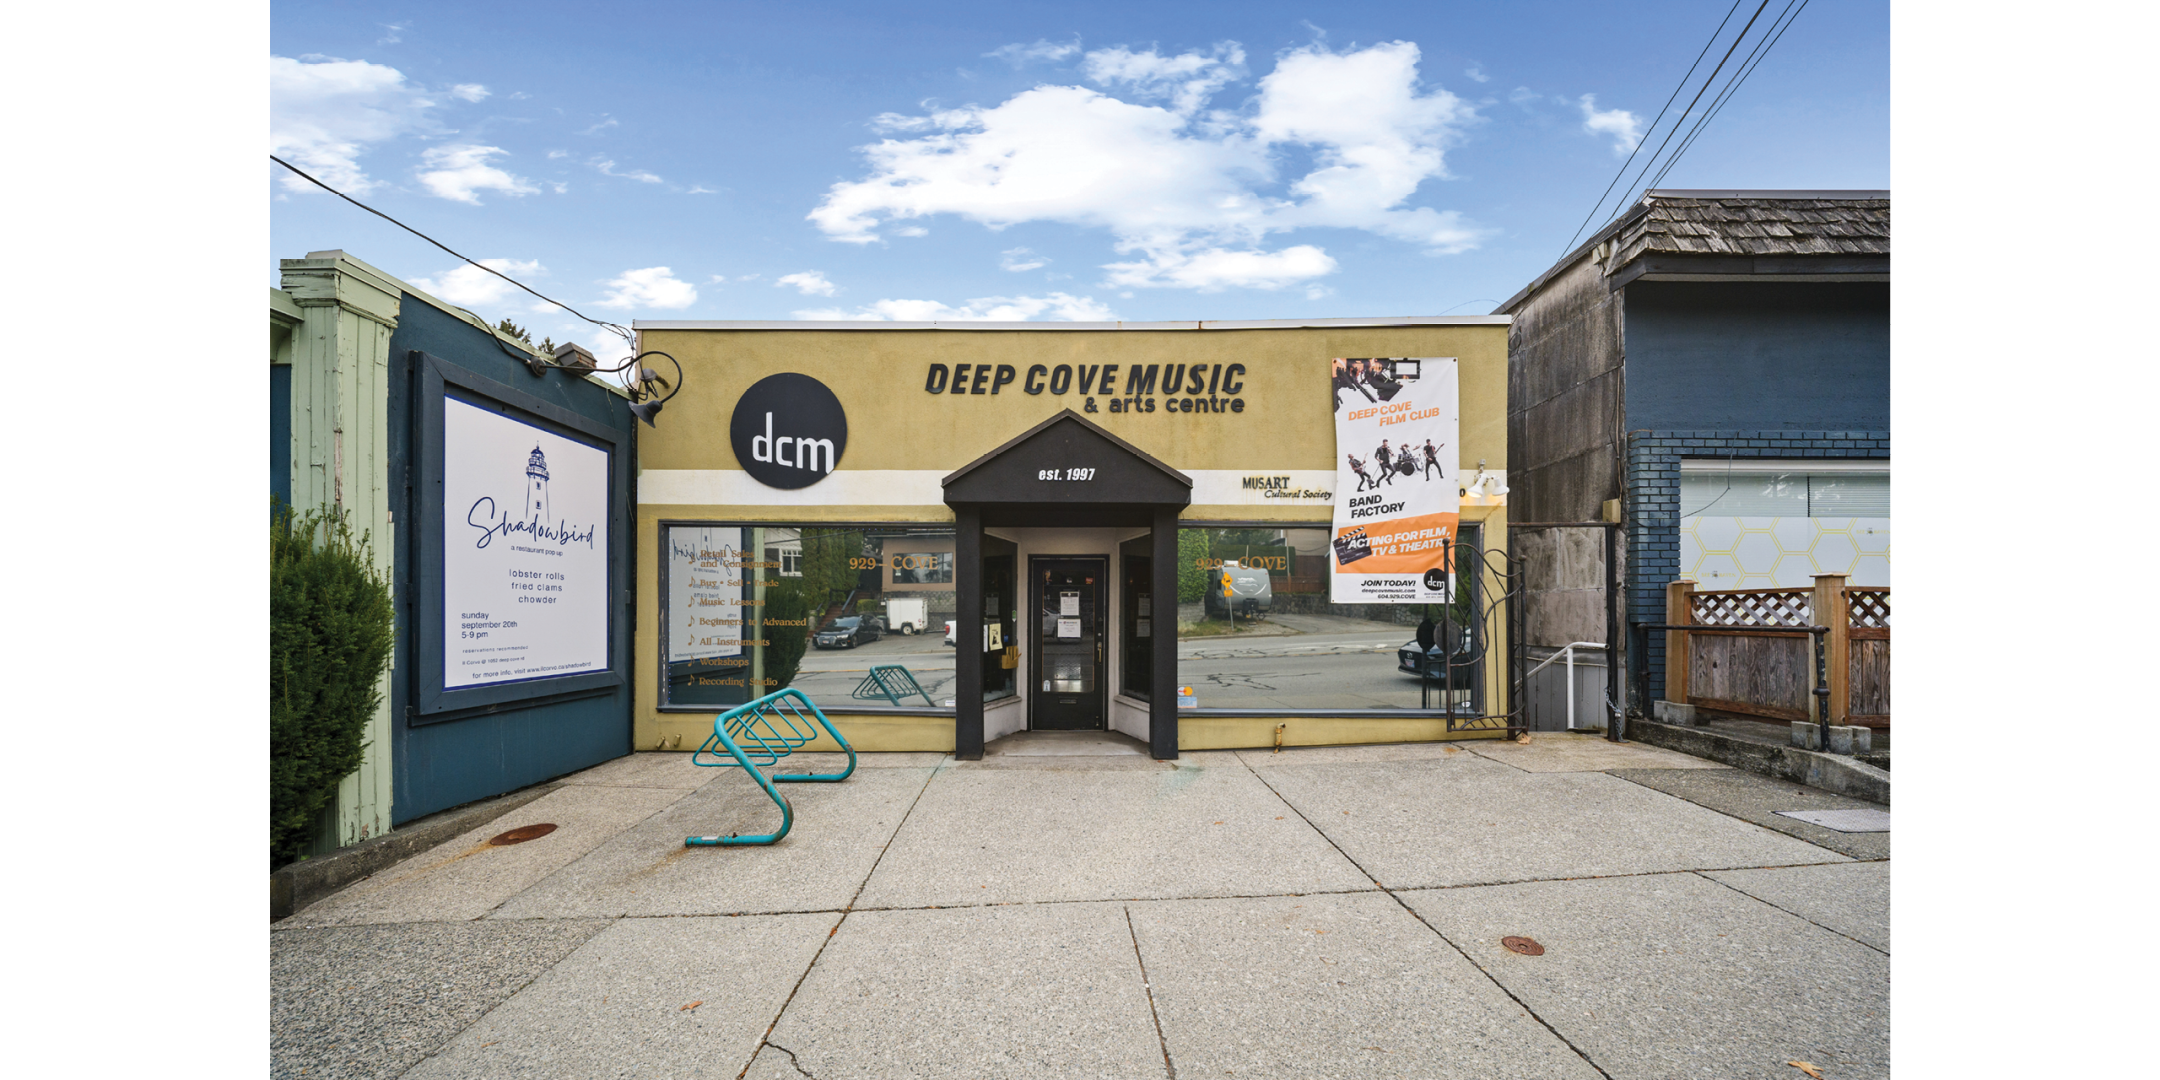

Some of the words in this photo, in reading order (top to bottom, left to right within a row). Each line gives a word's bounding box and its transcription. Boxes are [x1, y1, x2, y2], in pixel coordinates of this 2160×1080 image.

[925, 363, 1016, 395] DEEP
[1024, 363, 1119, 395] COVE
[1125, 363, 1246, 395] MUSIC
[1084, 397, 1098, 413] &
[1109, 395, 1156, 413] arts
[1165, 394, 1245, 413] centre
[1348, 407, 1378, 421] DEEP
[1379, 401, 1412, 415] COVE
[1379, 414, 1406, 427] FILM
[1409, 407, 1440, 421] CLUB
[752, 411, 834, 474] dcm
[1038, 469, 1062, 481] est.
[1066, 468, 1095, 481] 1997
[1242, 476, 1290, 489] MUSART
[1264, 489, 1301, 498] Cultural
[1302, 489, 1332, 500] Society
[1349, 494, 1382, 508] BAND
[1351, 502, 1405, 518] FACTORY
[467, 496, 594, 549] Shadowbird
[1347, 534, 1393, 549] ACTING
[1394, 530, 1419, 543] FOR
[1419, 526, 1451, 539] FILM,
[516, 546, 544, 554] restaurant
[1371, 546, 1387, 557] TV
[1388, 545, 1397, 554] &
[1399, 537, 1451, 553] THEATR
[700, 549, 726, 558] Retail
[731, 549, 755, 558] Sales
[700, 560, 718, 568] and
[722, 560, 783, 570] Consignment
[849, 557, 876, 570] 929
[890, 556, 938, 570] COVE
[1196, 557, 1223, 570] 929
[1238, 556, 1286, 570] COVE
[509, 568, 542, 579] lobster
[546, 571, 565, 581] rolls
[511, 582, 533, 590] fried
[537, 583, 563, 592] clams
[700, 580, 717, 588] Buy
[727, 579, 744, 587] Sell
[753, 579, 779, 587] Trade
[1427, 575, 1445, 587] dcm
[518, 595, 557, 604] chowder
[700, 598, 725, 606] Music
[730, 598, 765, 606] Lessons
[461, 611, 489, 621] sunday
[699, 617, 744, 627] Beginners
[748, 618, 757, 626] to
[762, 618, 807, 626] Advanced
[461, 621, 501, 630] september
[461, 631, 475, 639] 5-9
[476, 631, 489, 640] pm
[699, 637, 712, 646] All
[717, 637, 771, 647] Instruments
[700, 657, 749, 667] Workshops
[699, 677, 744, 687] Recording
[749, 677, 778, 686] Studio
